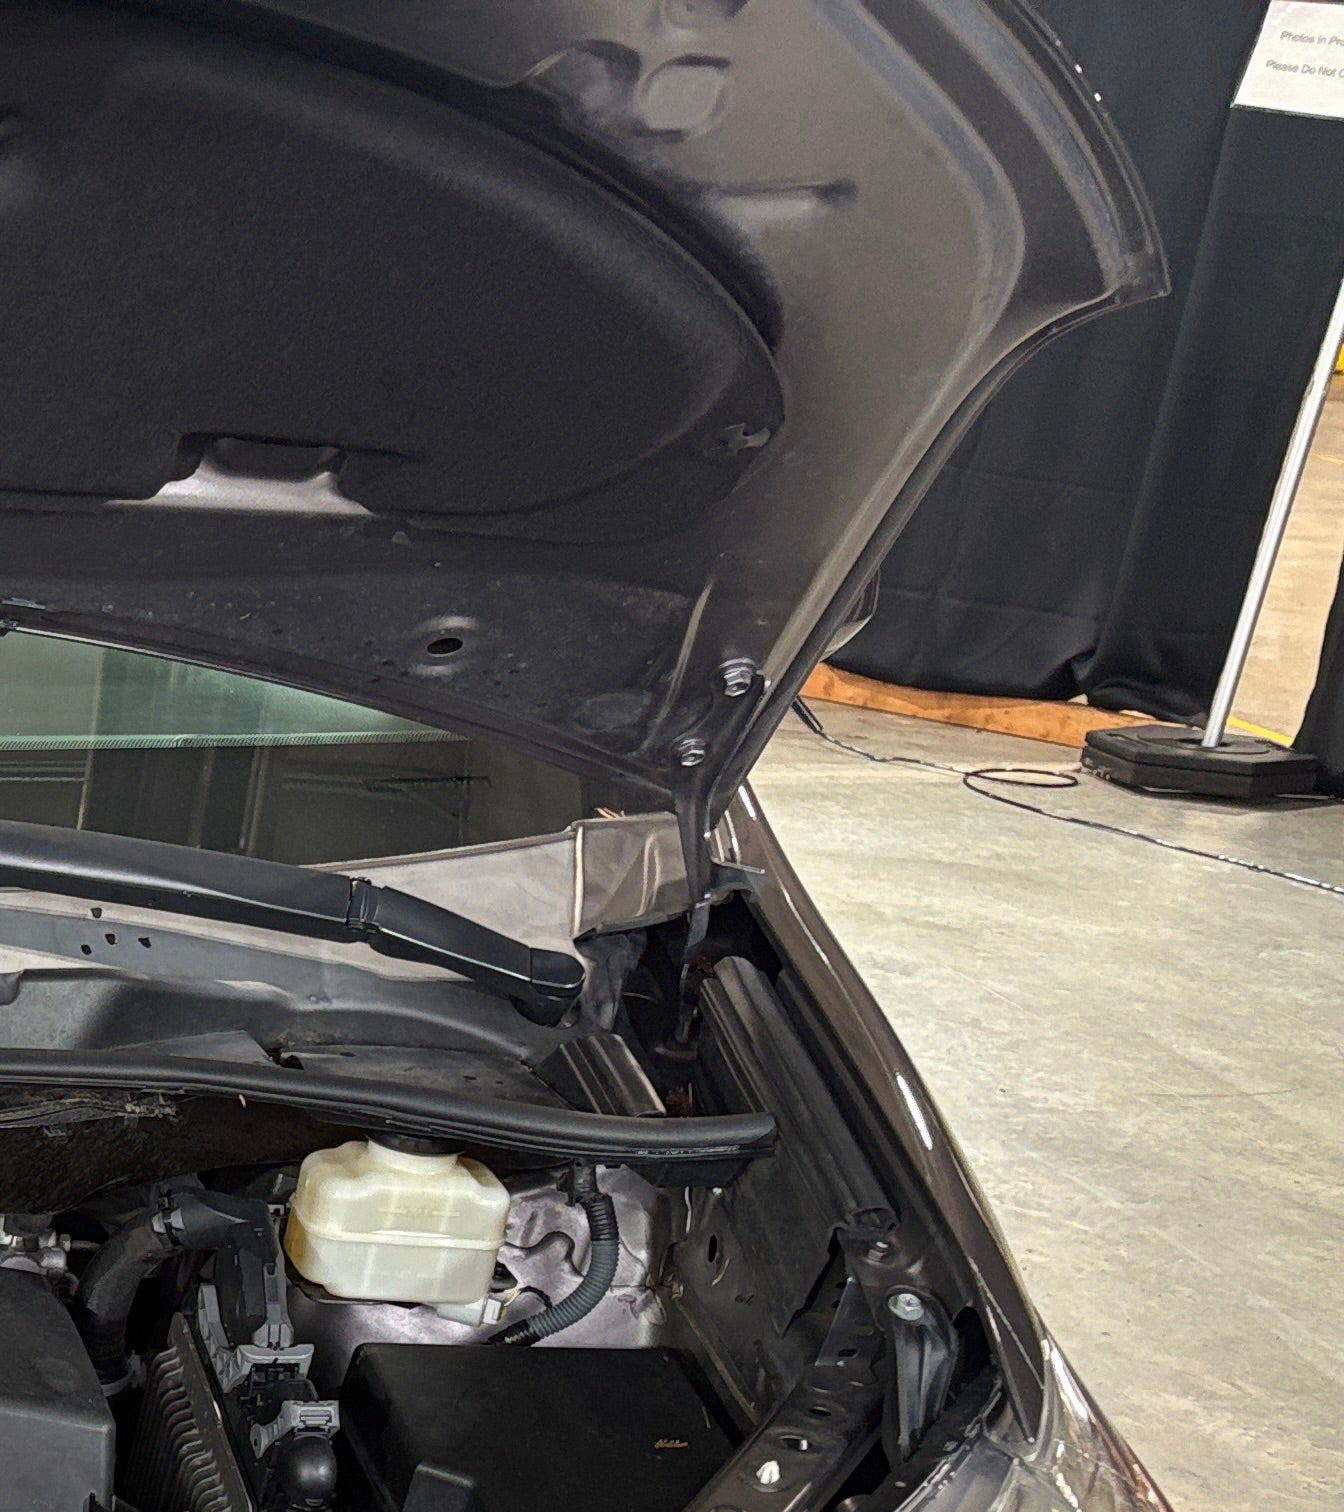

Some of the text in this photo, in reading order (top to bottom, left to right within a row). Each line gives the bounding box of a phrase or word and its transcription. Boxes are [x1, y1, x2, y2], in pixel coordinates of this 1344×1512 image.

[1280, 31, 1315, 43] Photos
[1266, 60, 1299, 73] Please
[1301, 64, 1316, 74] Do
[1318, 66, 1337, 77] Not
